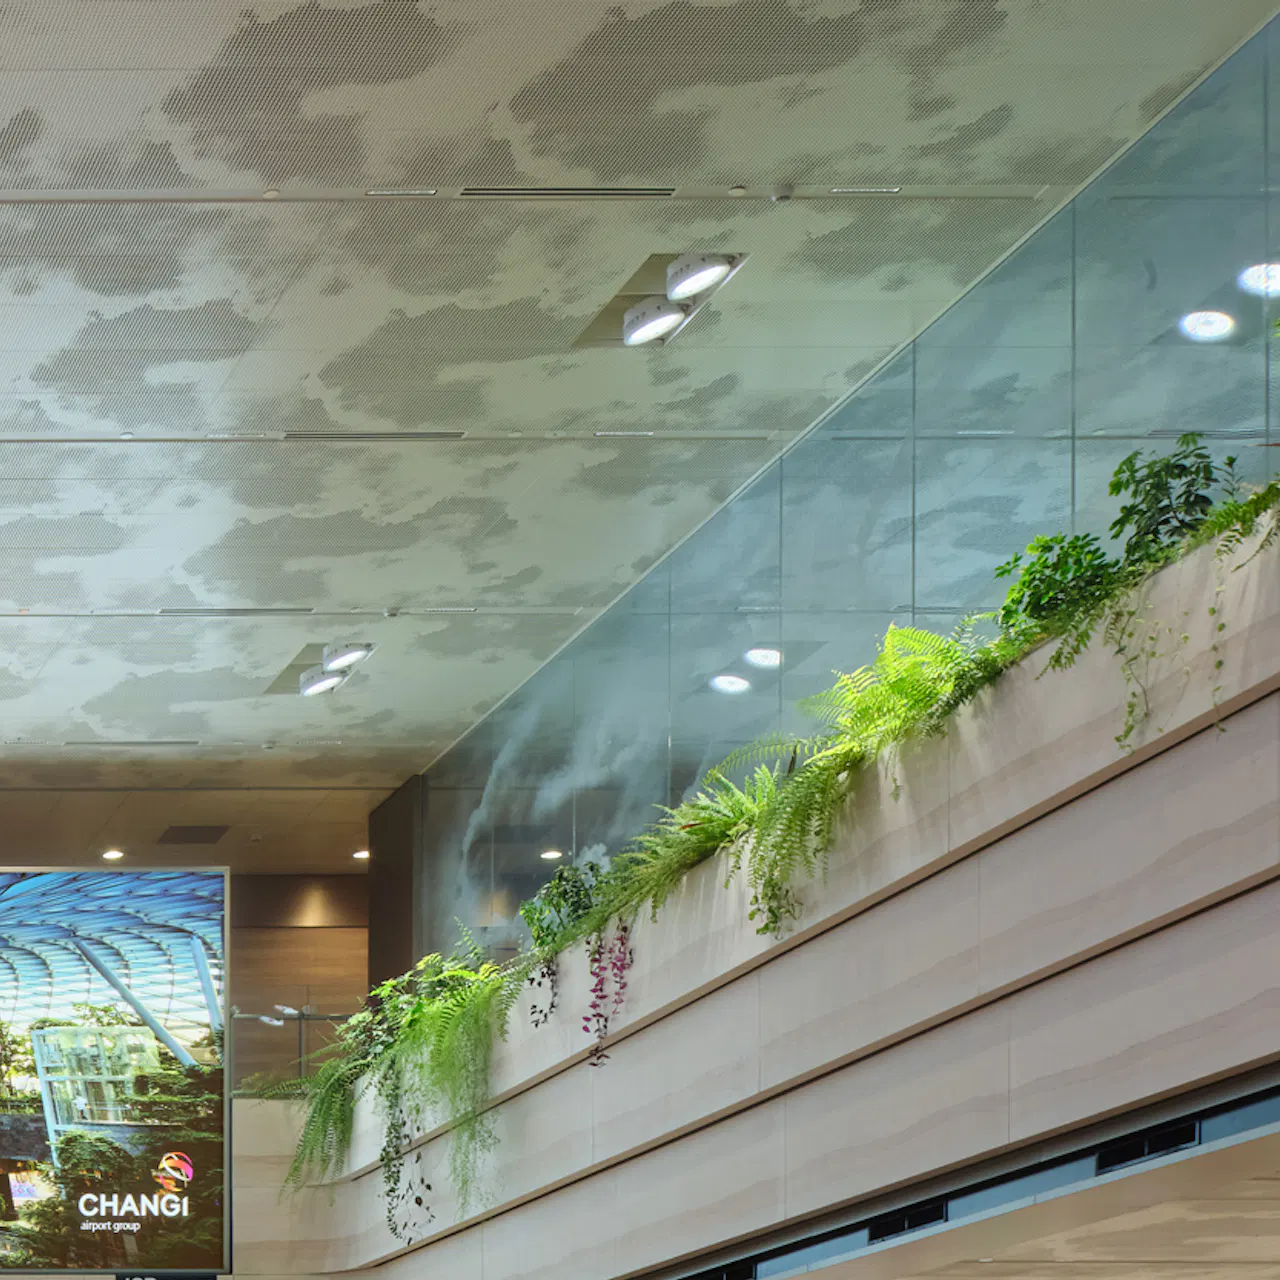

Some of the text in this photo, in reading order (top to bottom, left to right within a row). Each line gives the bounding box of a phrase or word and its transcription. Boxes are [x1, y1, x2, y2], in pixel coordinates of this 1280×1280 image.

[78, 1193, 190, 1217] CHANGI
[80, 1220, 141, 1233] airport group
